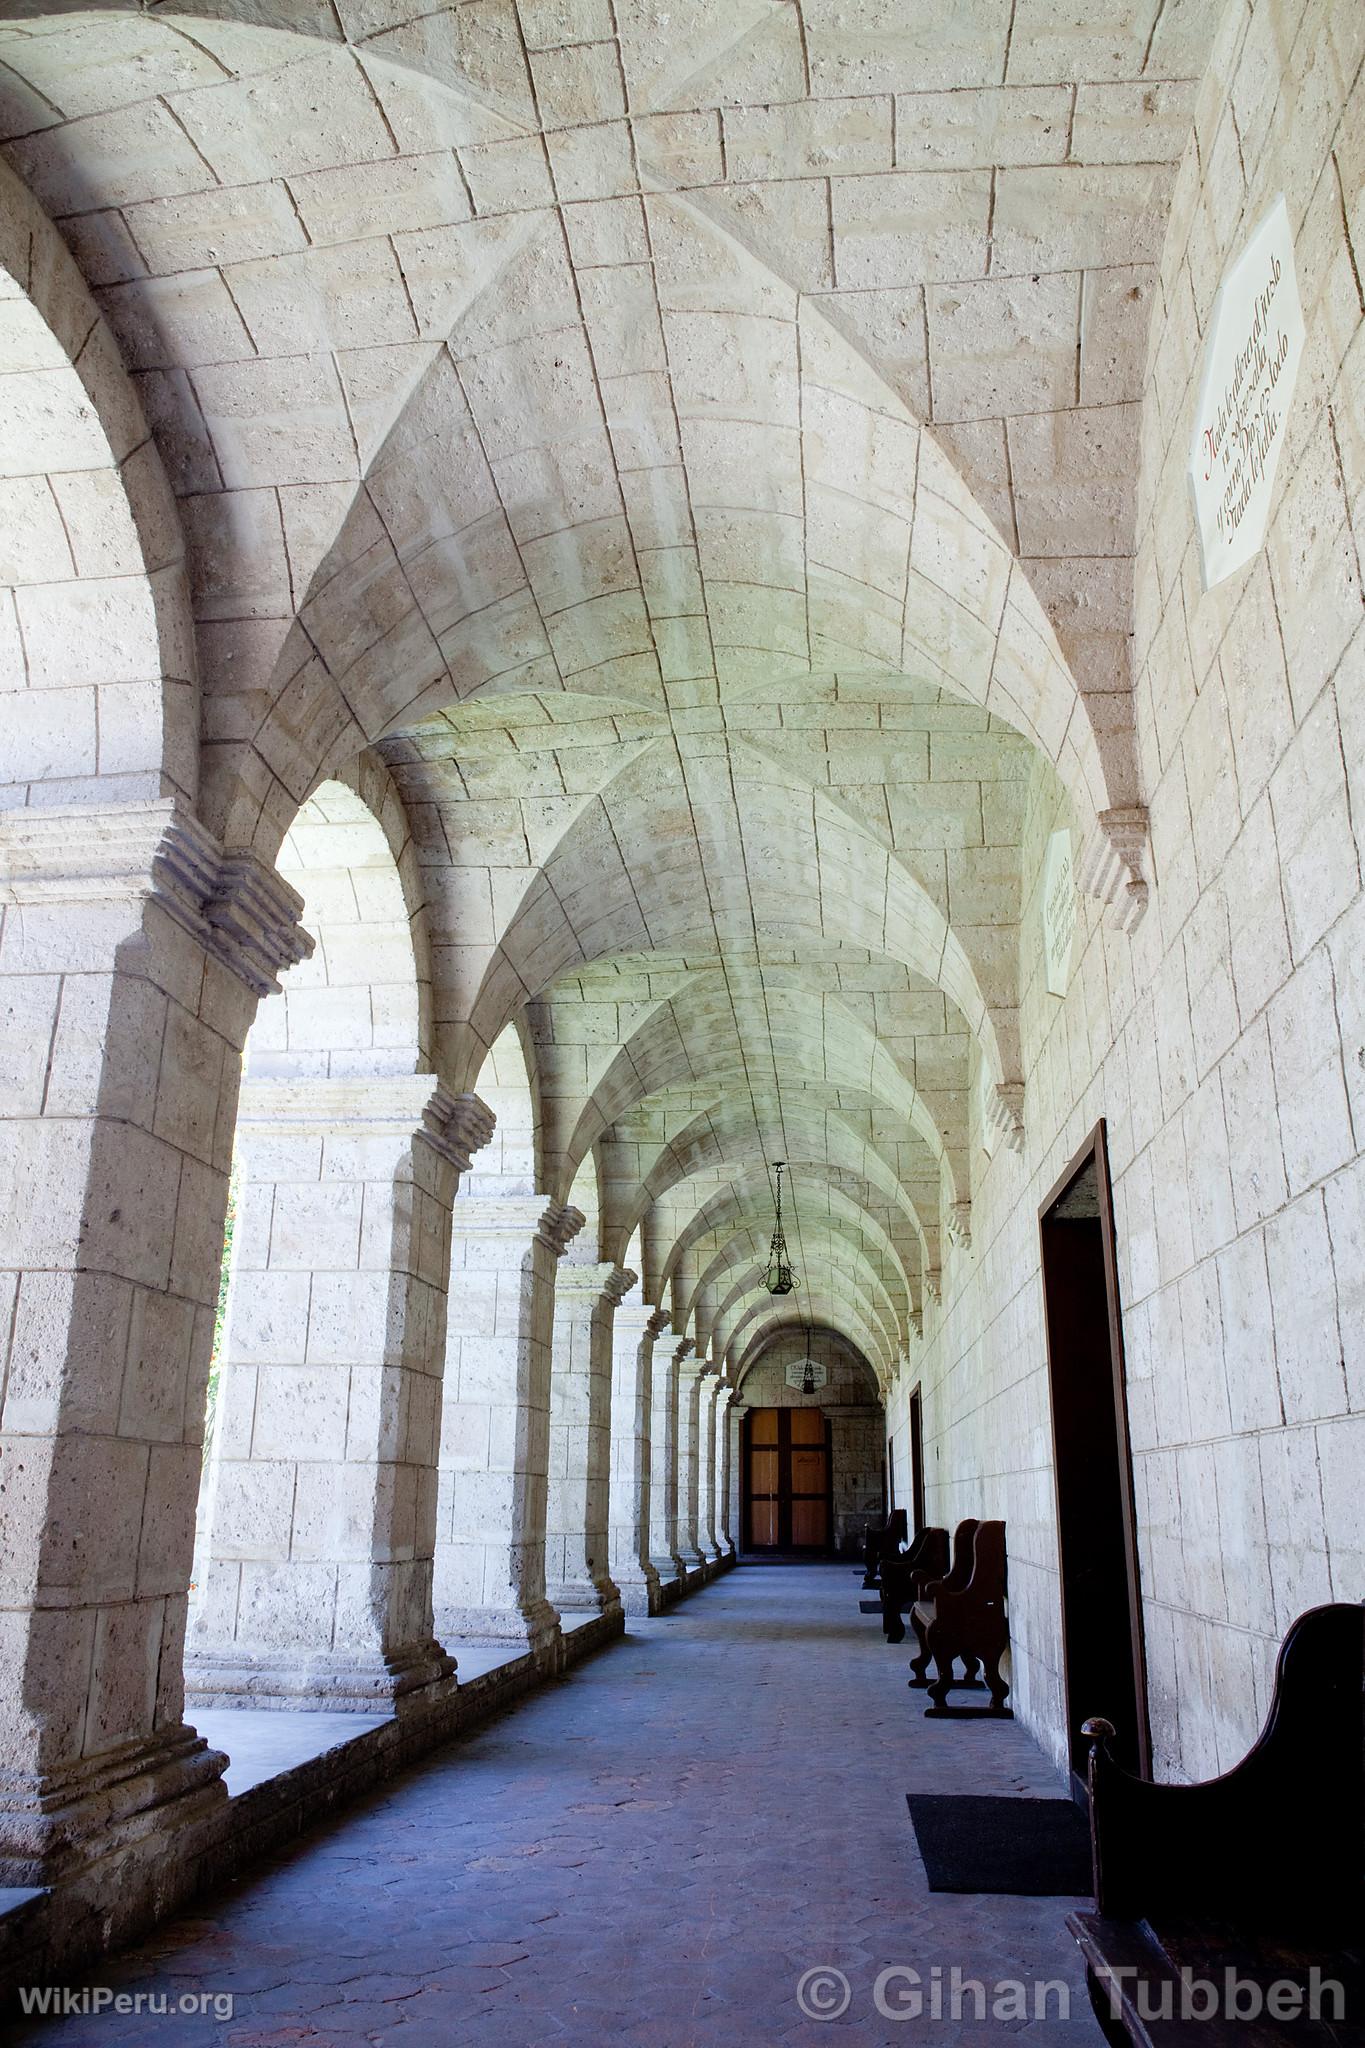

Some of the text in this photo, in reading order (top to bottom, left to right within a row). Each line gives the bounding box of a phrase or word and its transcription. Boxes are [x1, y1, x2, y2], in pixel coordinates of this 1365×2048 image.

[1203, 405, 1227, 480] Nada
[1260, 253, 1281, 336] justo
[1240, 413, 1261, 468] Dios
[1268, 328, 1288, 388] todo
[1226, 473, 1251, 545] Nada
